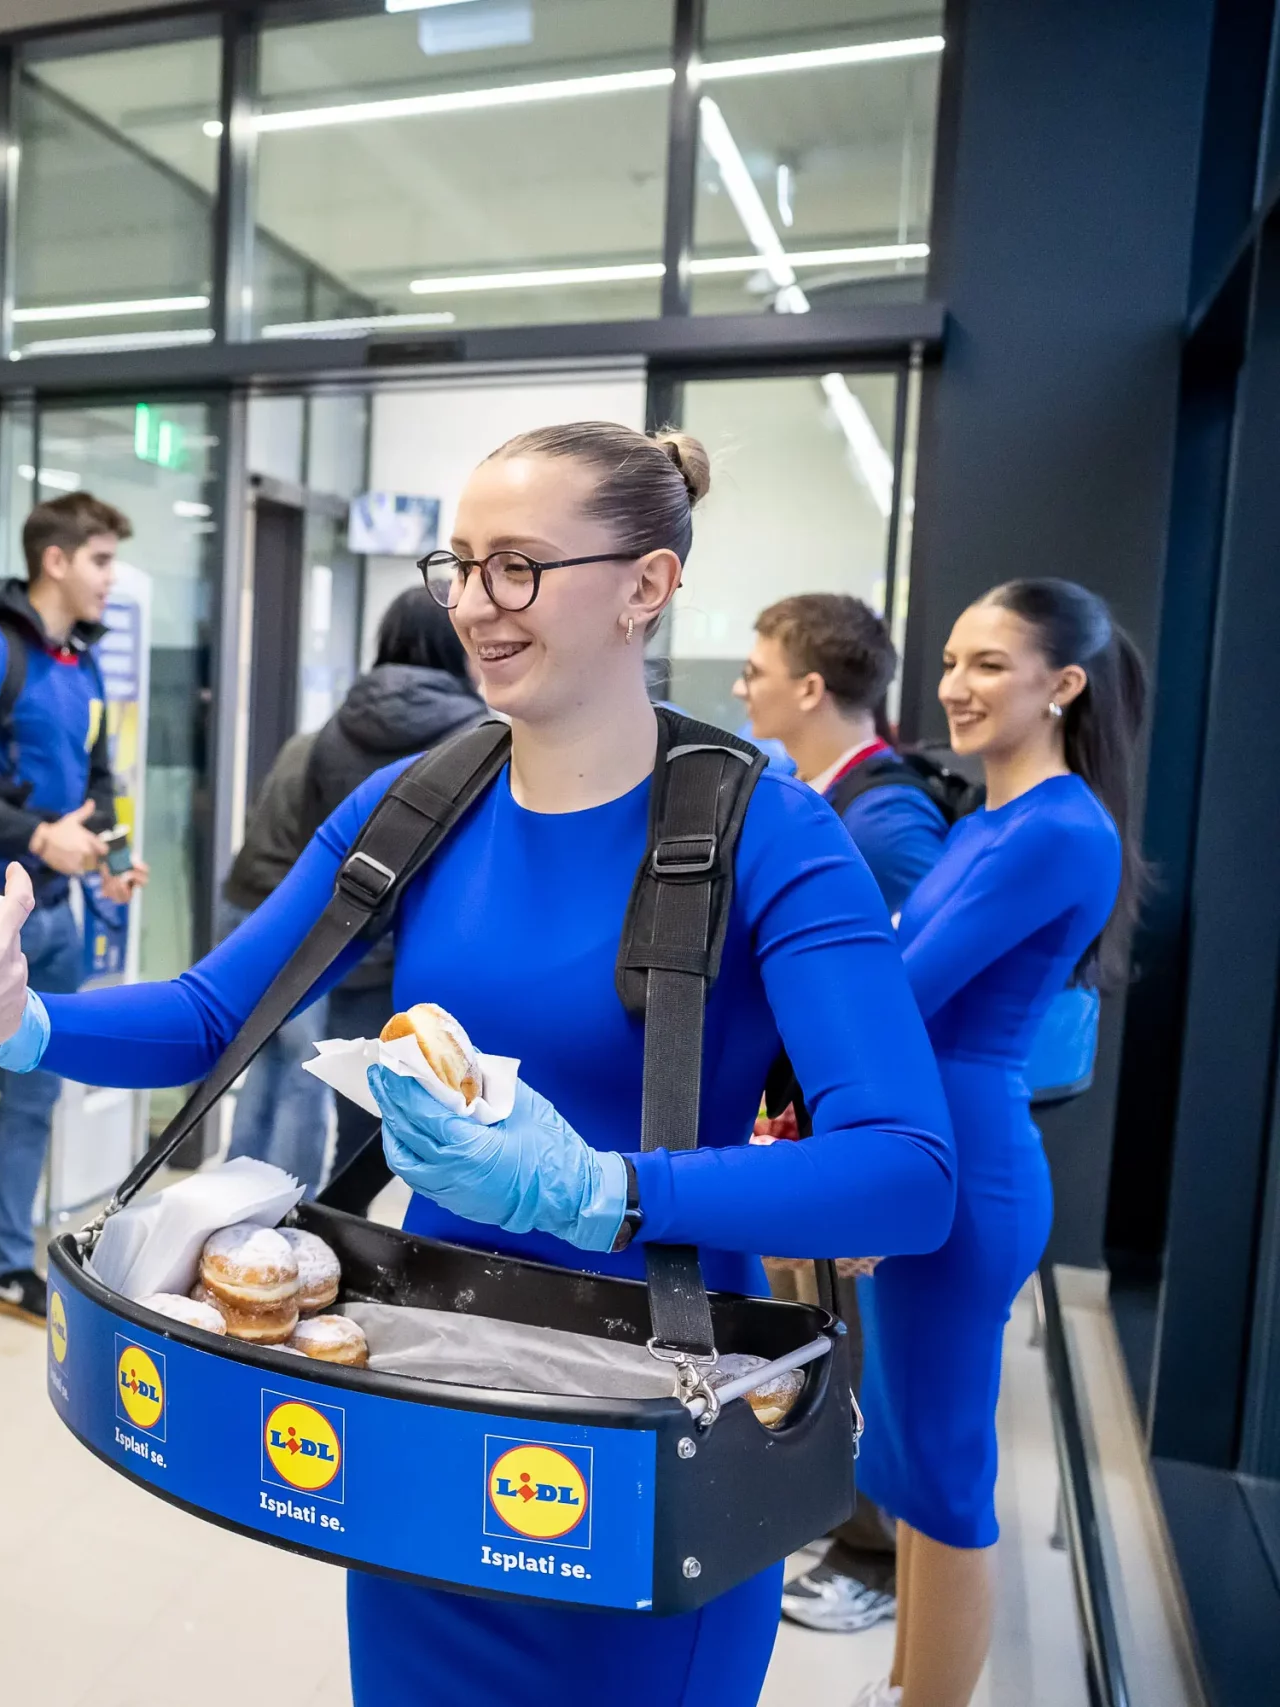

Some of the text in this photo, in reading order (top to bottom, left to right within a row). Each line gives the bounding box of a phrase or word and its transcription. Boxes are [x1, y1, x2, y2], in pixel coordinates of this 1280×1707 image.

[115, 1426, 167, 1468] Isplati se.
[259, 1491, 346, 1533] Isplati se.
[481, 1546, 592, 1580] Isplati se.
